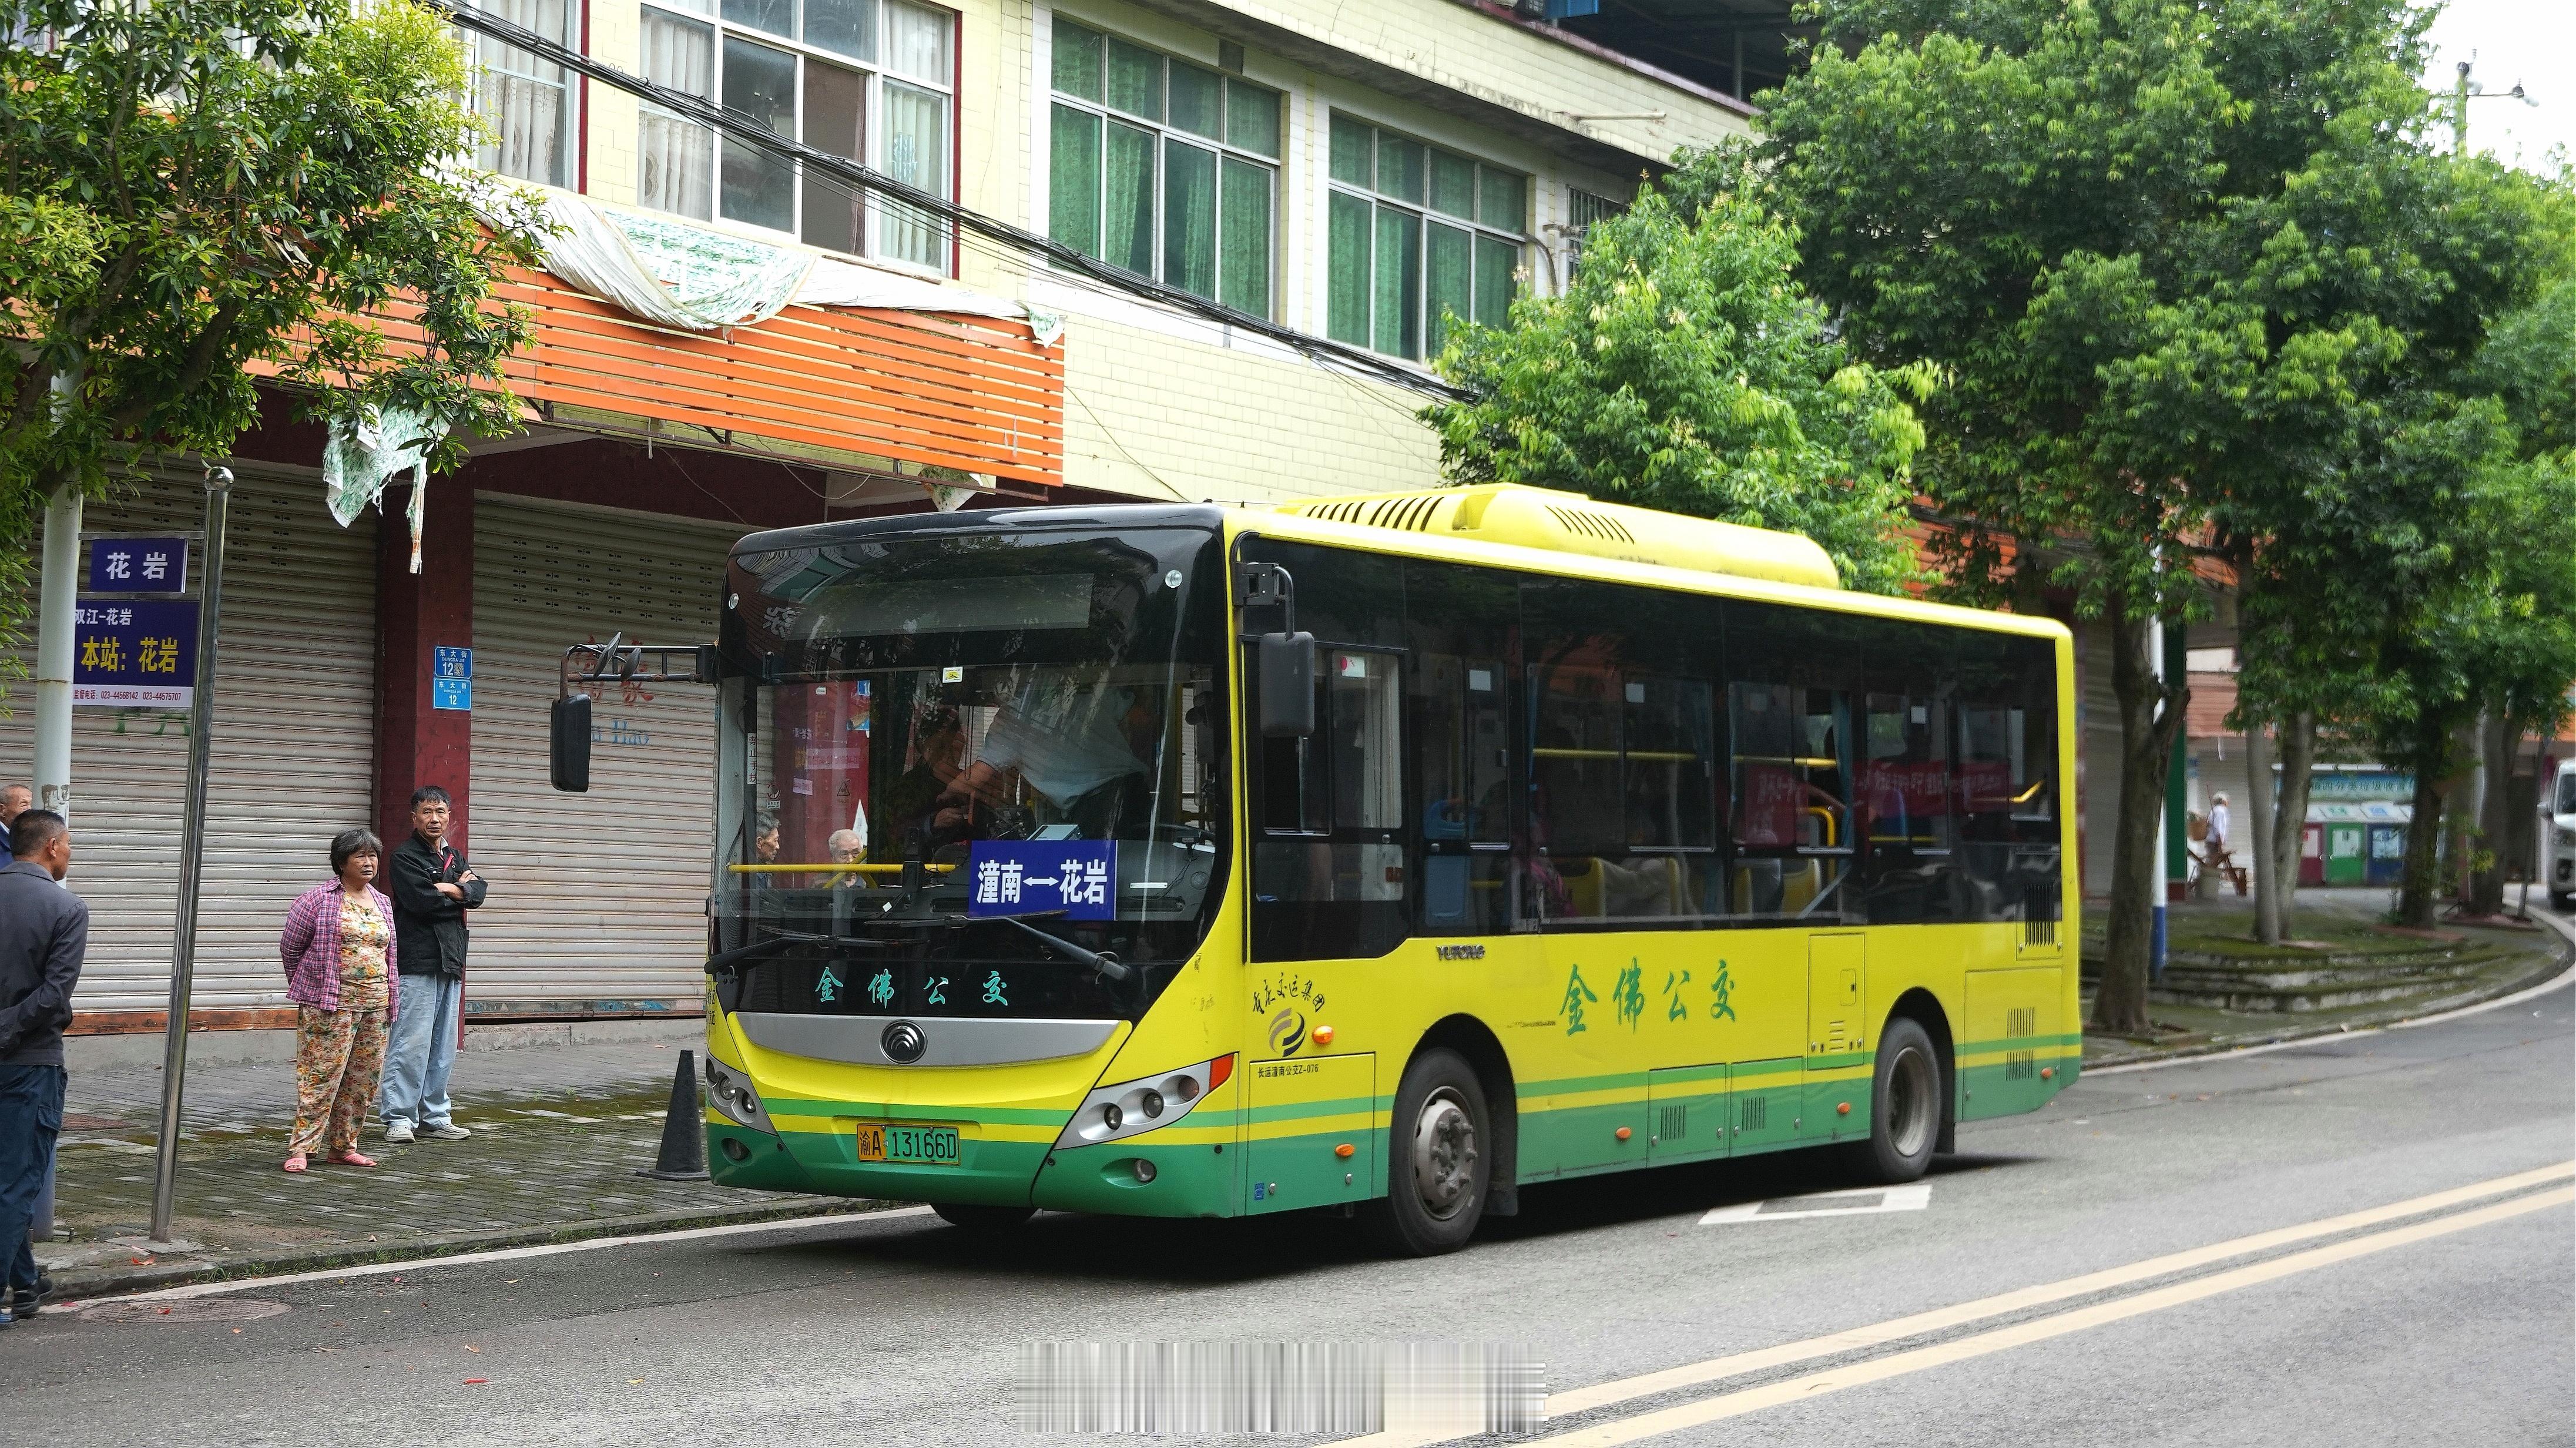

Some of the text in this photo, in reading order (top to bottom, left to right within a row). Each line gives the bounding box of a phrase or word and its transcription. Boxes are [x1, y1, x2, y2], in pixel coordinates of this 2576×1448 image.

[106, 552, 168, 579] 花岩
[440, 649, 467, 658] 东大街
[442, 662, 454, 676] 12
[438, 681, 467, 689] 东大街
[143, 692, 182, 701] 023-44575707
[449, 695, 457, 705] 12
[977, 859, 1108, 904] 潼南 花岩
[1436, 944, 1485, 961] YUTONG
[815, 966, 1008, 1010] 金佛公交
[1558, 956, 1736, 1037] 金佛公交
